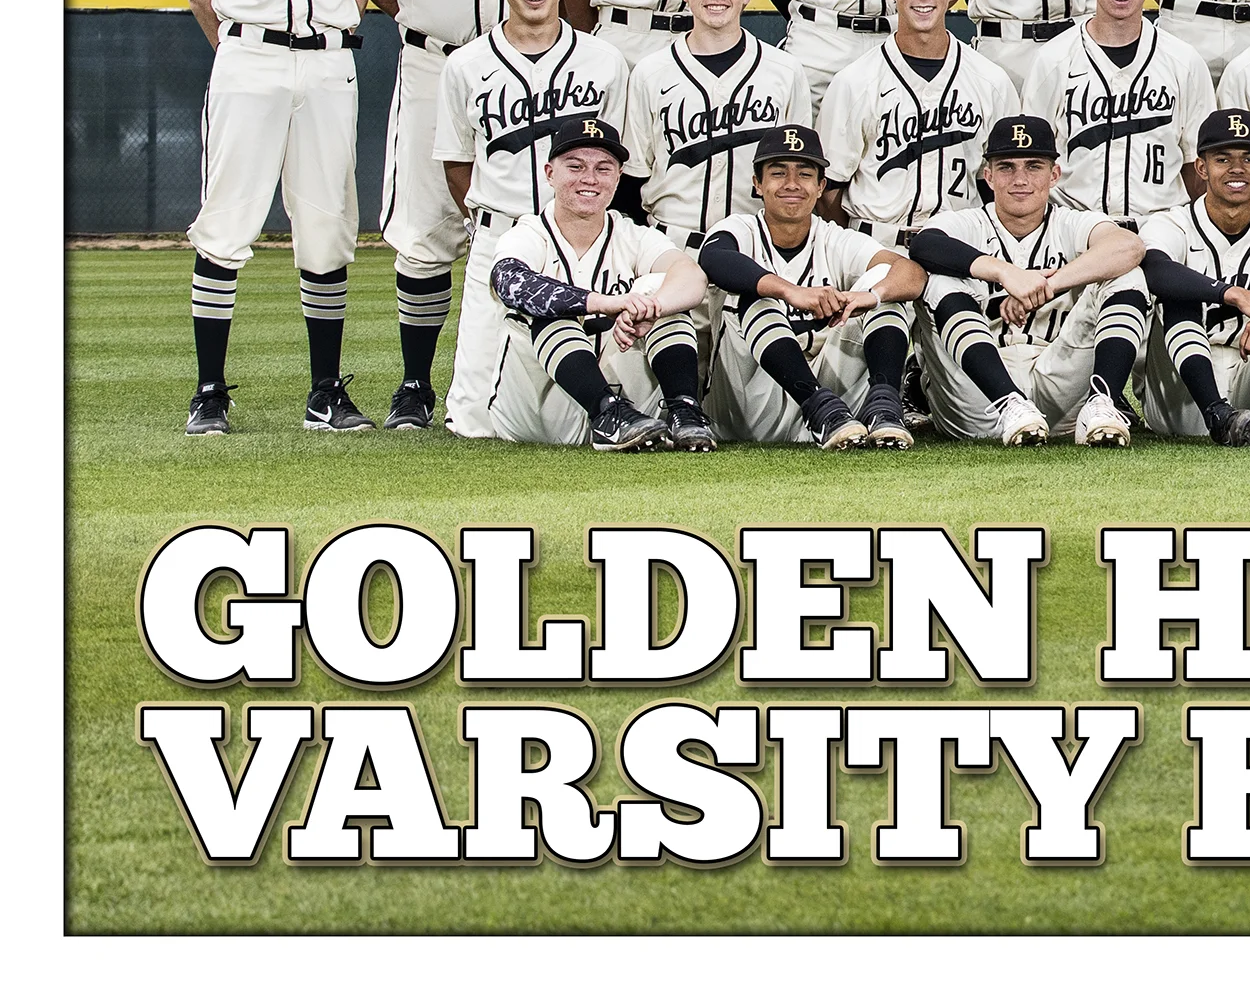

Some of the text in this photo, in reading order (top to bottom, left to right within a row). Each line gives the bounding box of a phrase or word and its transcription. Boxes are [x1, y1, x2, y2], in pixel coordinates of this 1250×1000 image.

[476, 71, 604, 141] Hawks
[660, 85, 778, 155] Hawks
[876, 89, 981, 160] Hawks
[1065, 76, 1175, 136] Hawks
[1143, 144, 1165, 185] 16
